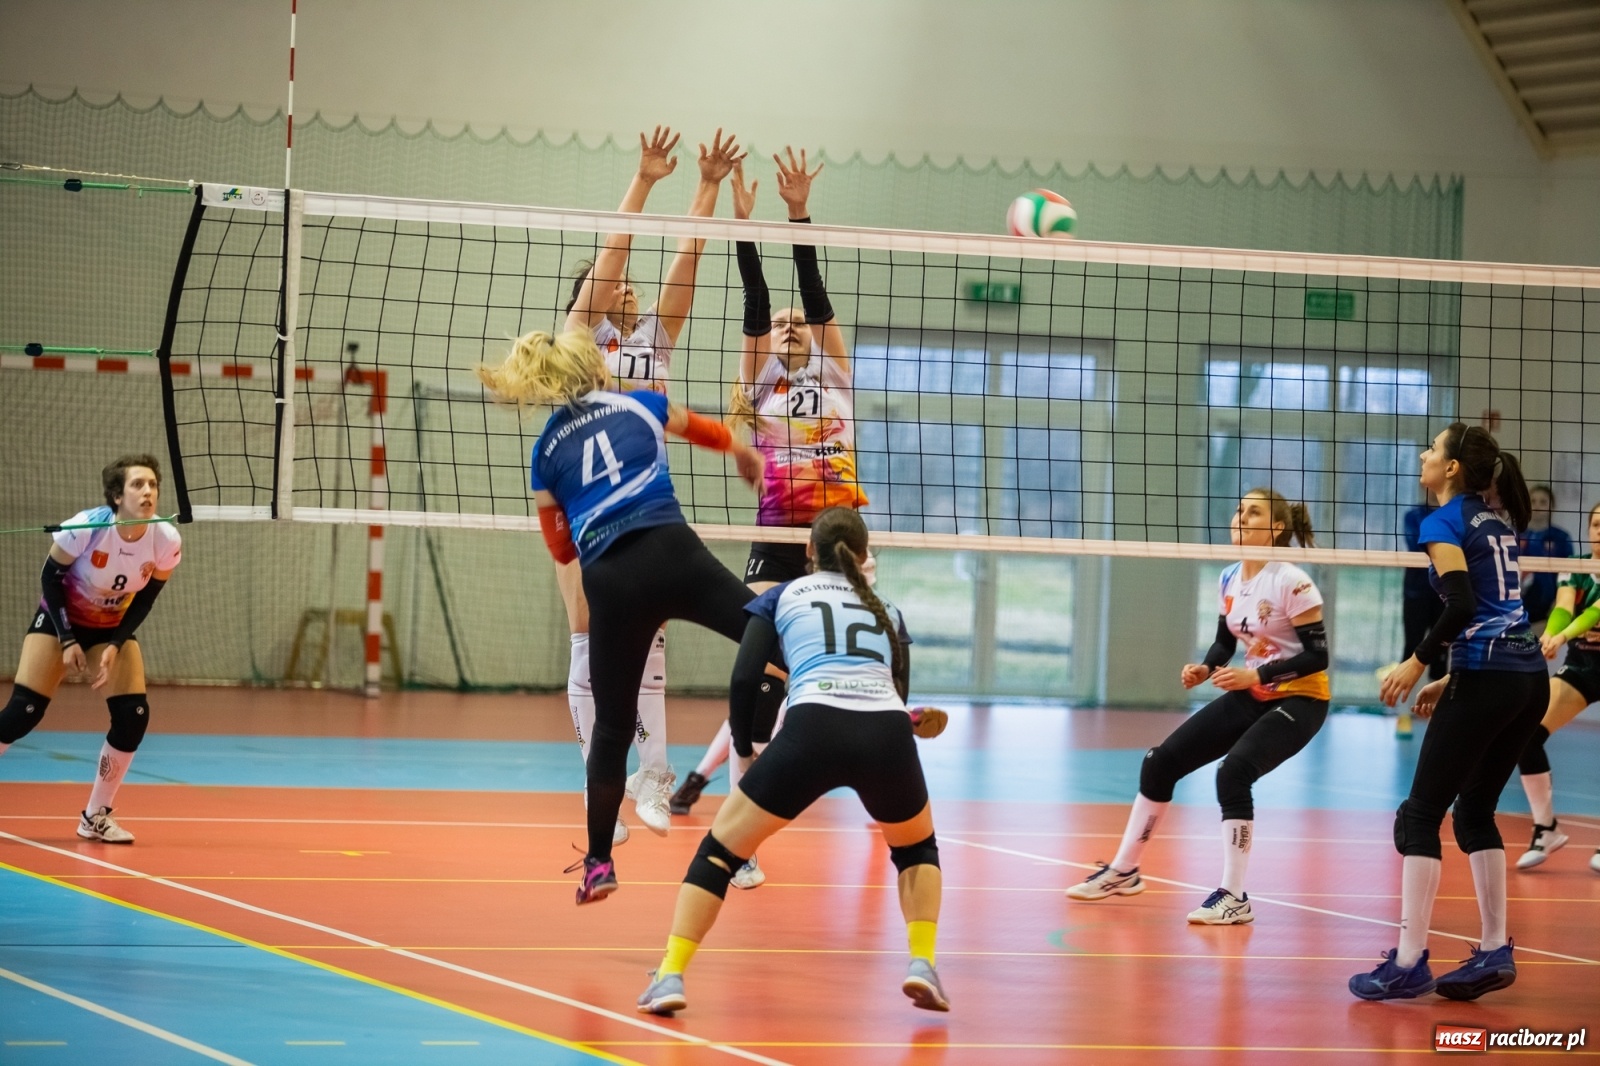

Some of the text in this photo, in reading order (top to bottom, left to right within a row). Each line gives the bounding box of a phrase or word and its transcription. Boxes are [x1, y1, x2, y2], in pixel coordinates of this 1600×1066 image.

[790, 389, 819, 417] 27
[557, 413, 593, 442] JEDYNKA
[582, 429, 624, 487] 4
[1487, 535, 1521, 601] 15
[111, 574, 128, 591] 8
[792, 586, 811, 596] UKS
[34, 613, 45, 629] 8
[811, 601, 884, 664] 12
[1240, 616, 1254, 638] 4
